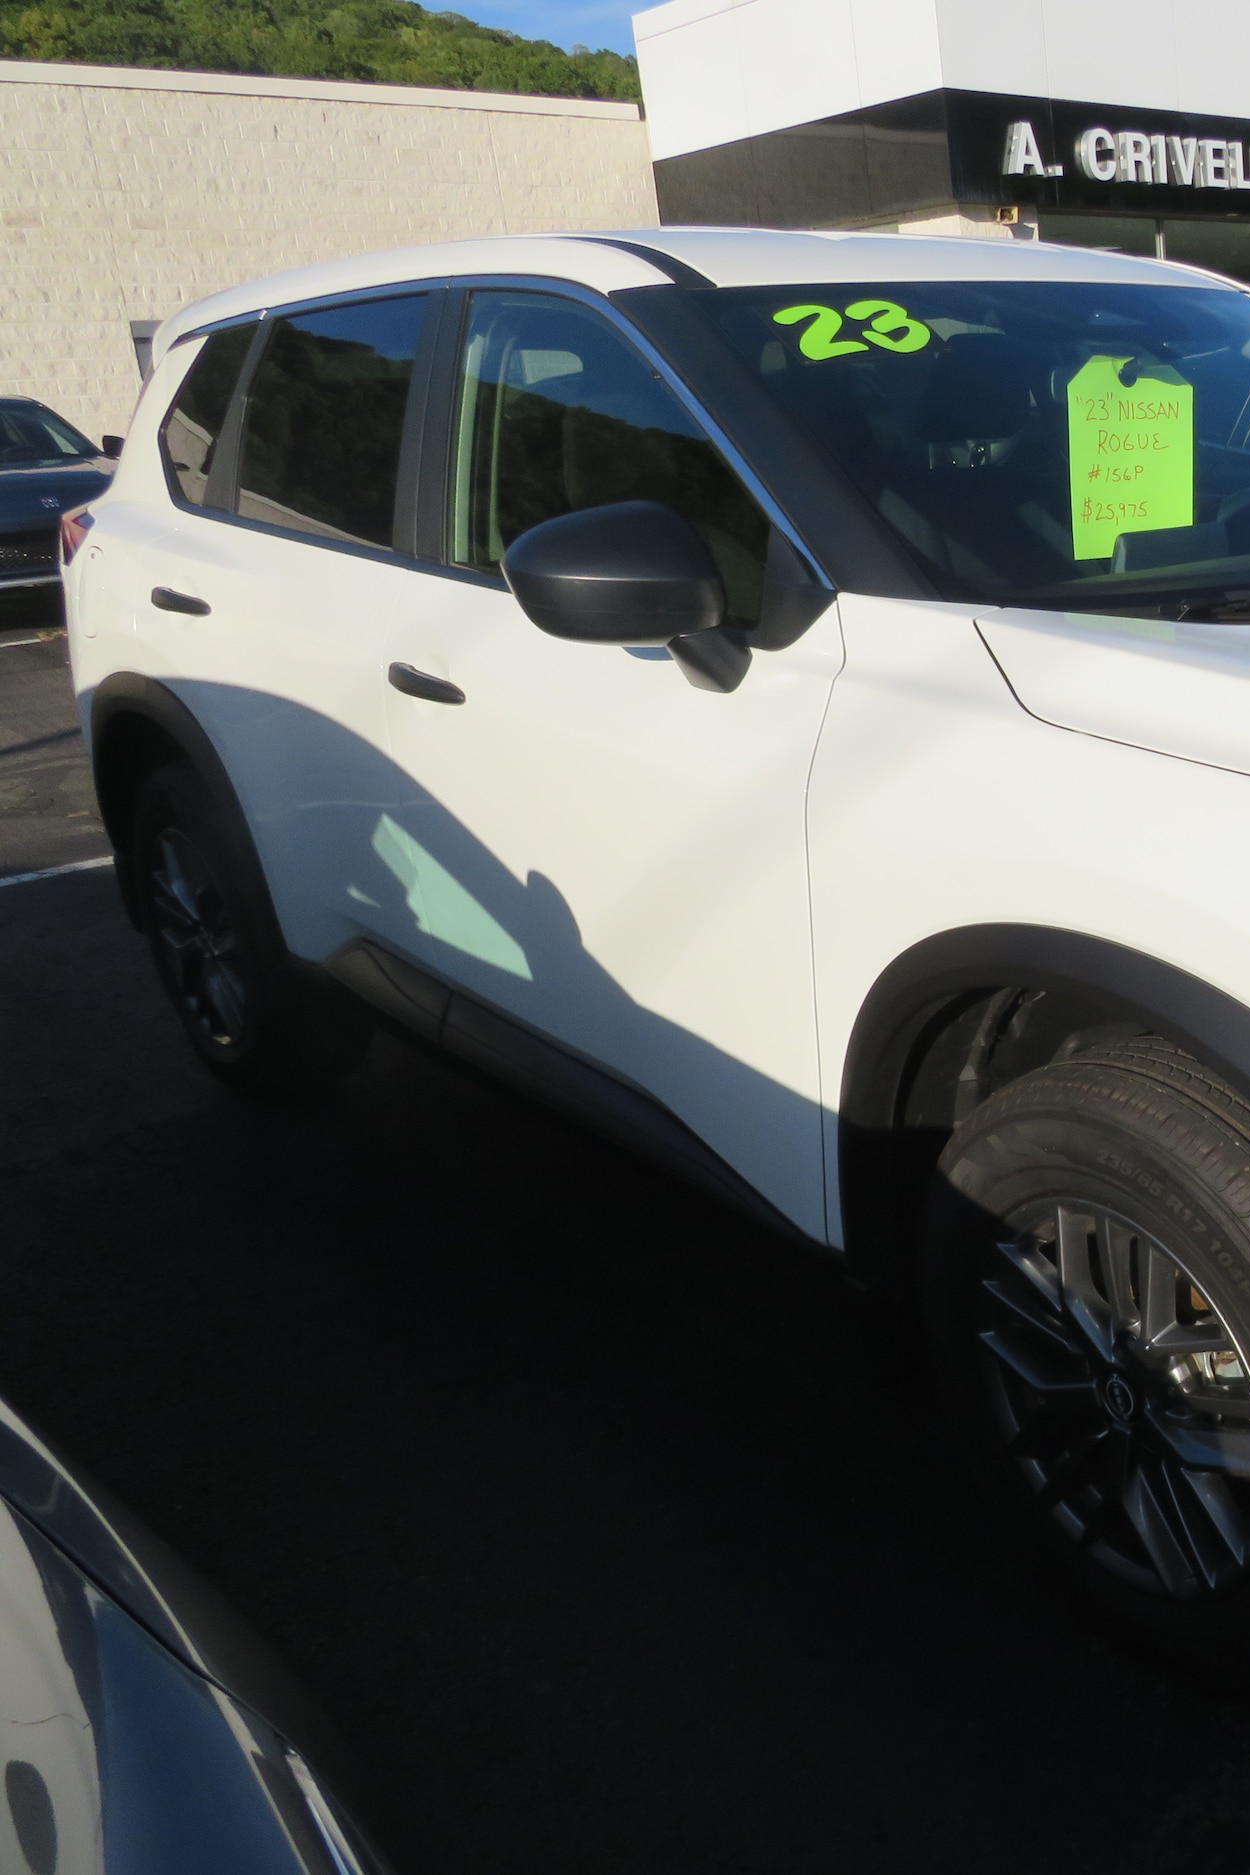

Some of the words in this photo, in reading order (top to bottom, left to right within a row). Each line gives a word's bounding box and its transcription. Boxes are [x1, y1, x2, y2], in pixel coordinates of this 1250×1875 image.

[1003, 121, 1063, 176] A.
[772, 299, 931, 362] 23
[1118, 400, 1179, 421] NISSAN
[1097, 429, 1170, 455] ROGUE
[1080, 497, 1149, 527] $25,975
